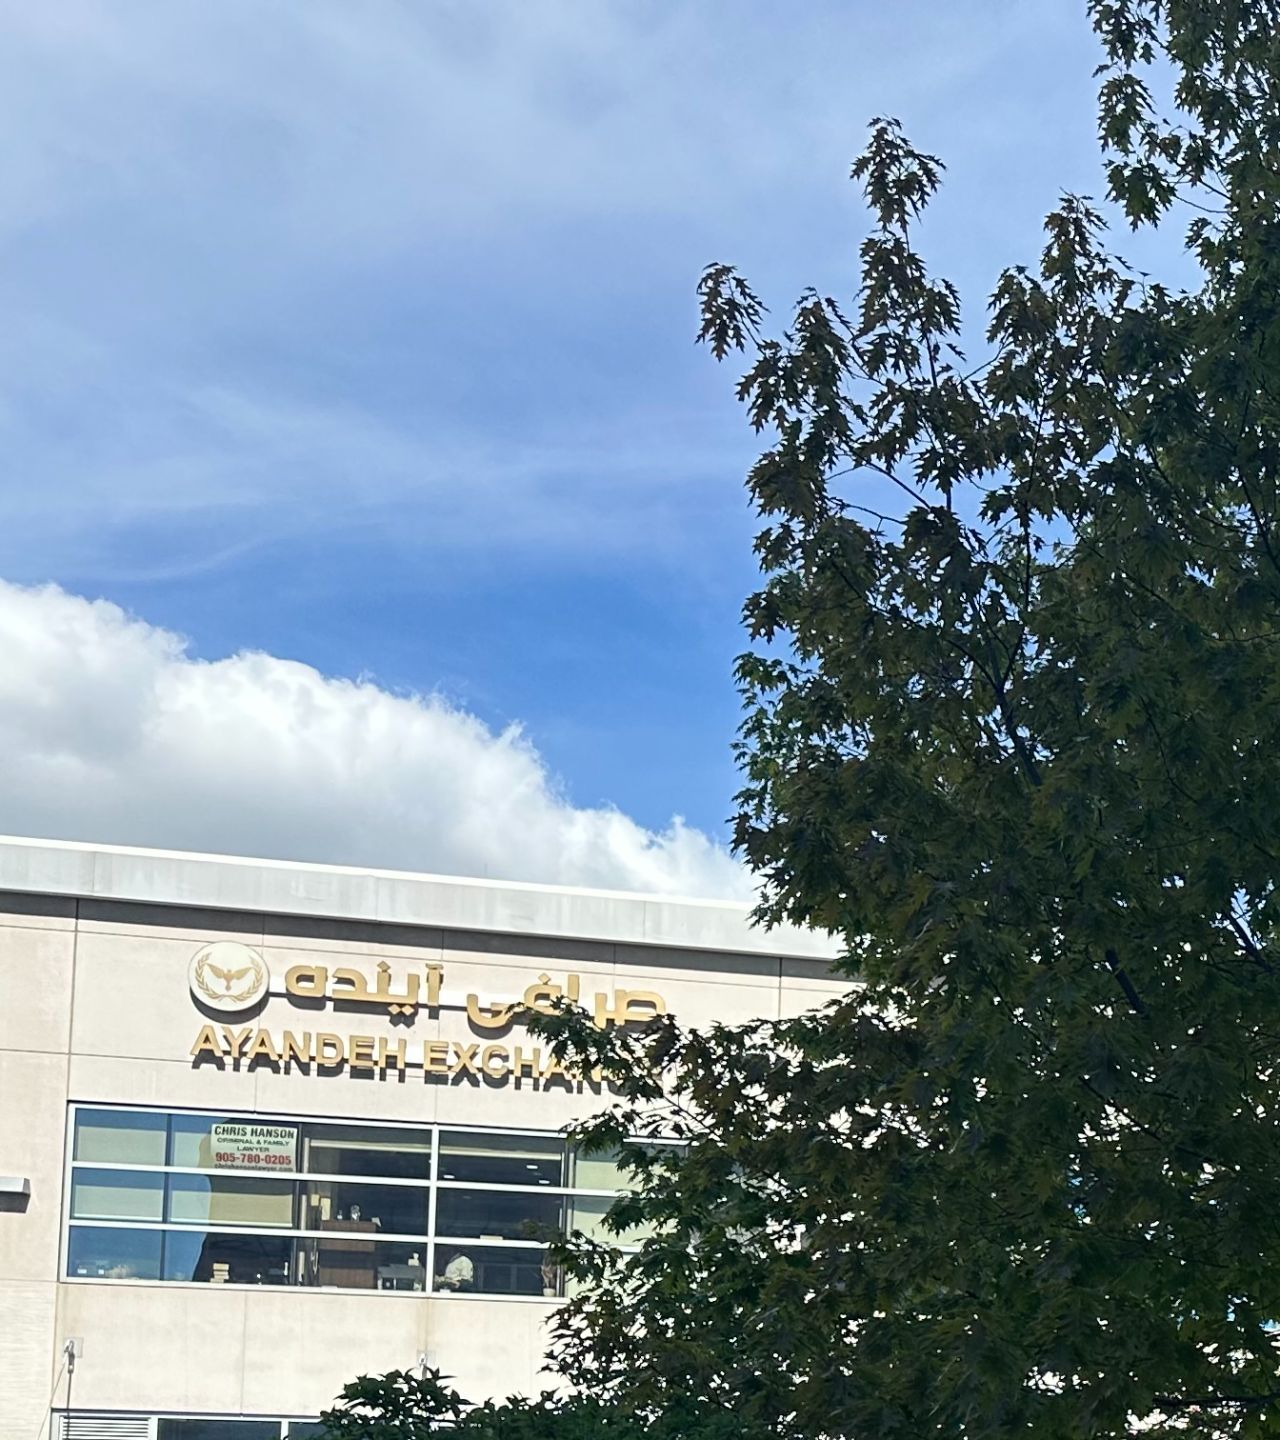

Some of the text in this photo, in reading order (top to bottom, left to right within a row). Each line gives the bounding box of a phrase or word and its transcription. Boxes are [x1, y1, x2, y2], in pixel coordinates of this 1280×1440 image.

[190, 1024, 406, 1069] AYANDEH
[215, 1126, 294, 1139] CHRIS HANSON
[237, 1145, 270, 1153] LAWYER
[215, 1152, 292, 1165] 905-780-0205
